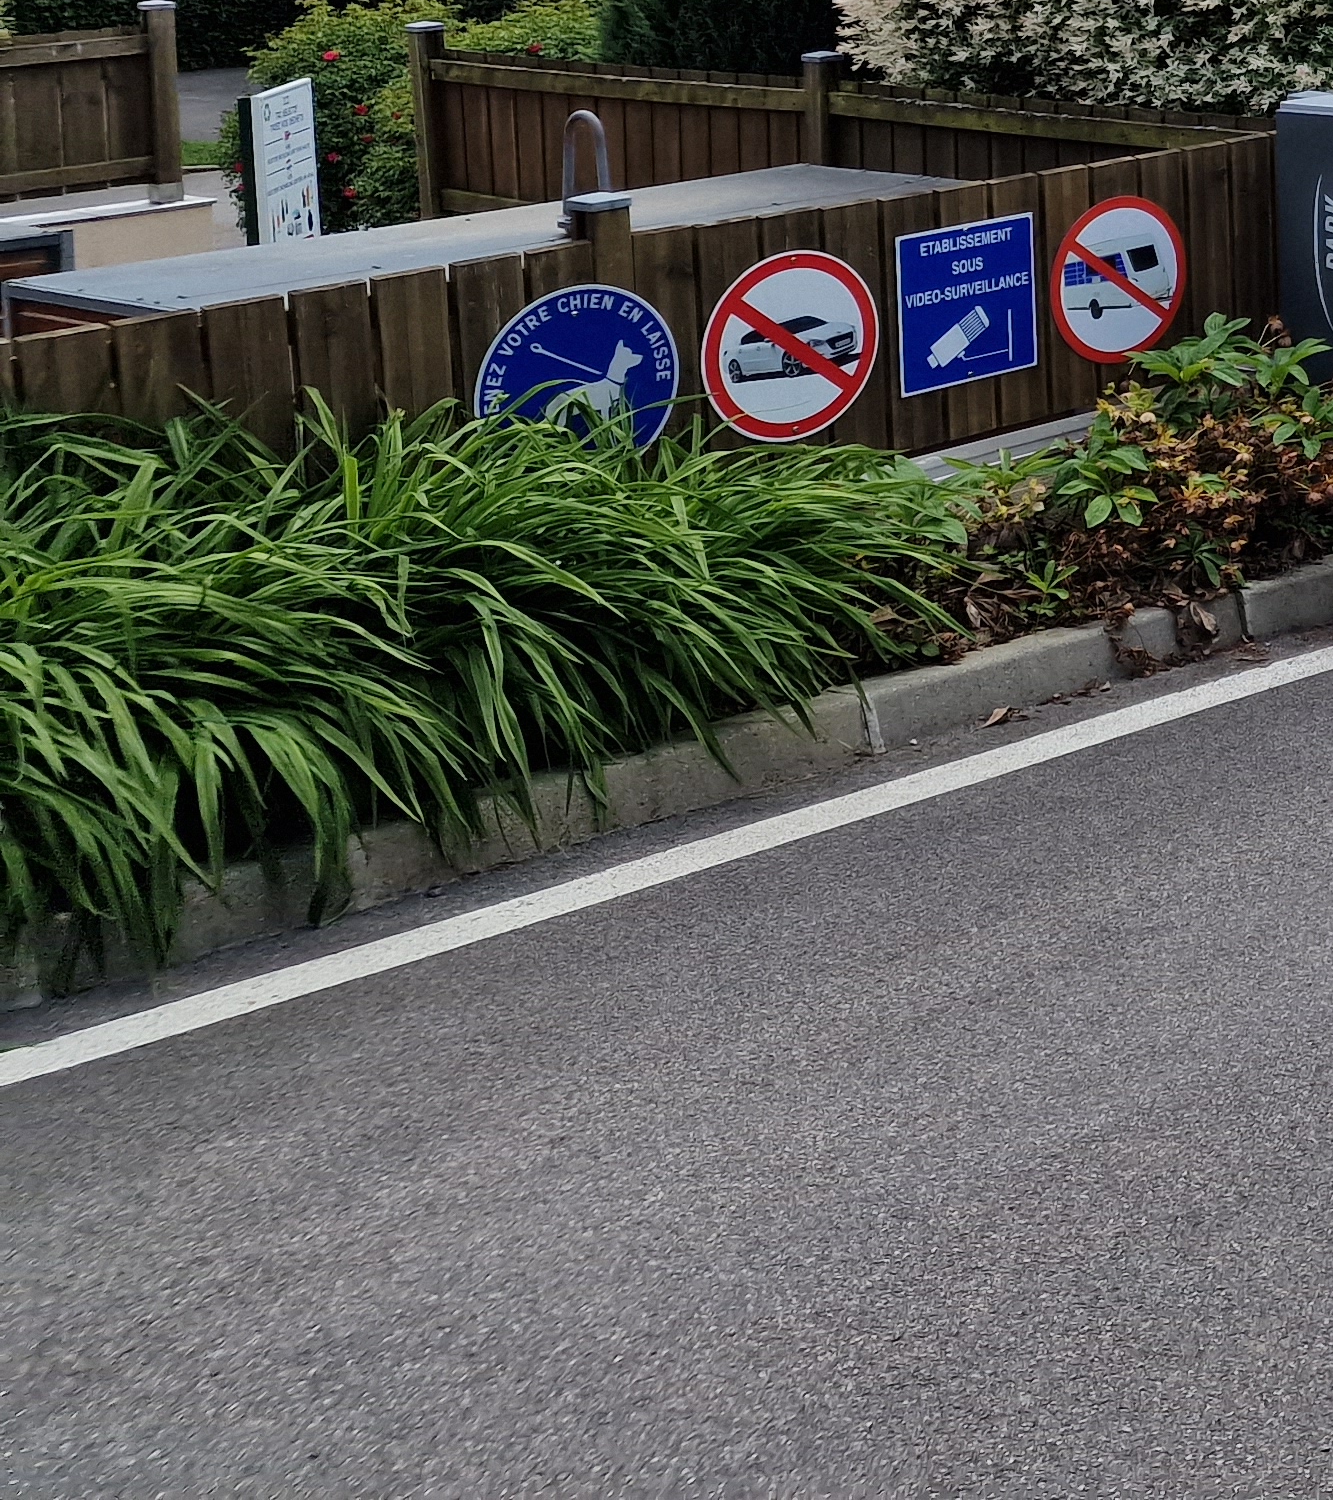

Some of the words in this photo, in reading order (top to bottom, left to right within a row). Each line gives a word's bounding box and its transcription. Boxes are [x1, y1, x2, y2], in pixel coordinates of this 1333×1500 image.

[919, 226, 1013, 258] ETABLISSEMENT
[951, 256, 984, 275] SOUS
[904, 270, 1030, 309] VIDEO-SURVEILLANCE
[483, 362, 507, 415] ENEZ
[497, 305, 552, 357] VOTRE
[557, 293, 615, 313] CHIEN
[618, 301, 644, 324] EN
[640, 320, 672, 382] LAISSE
